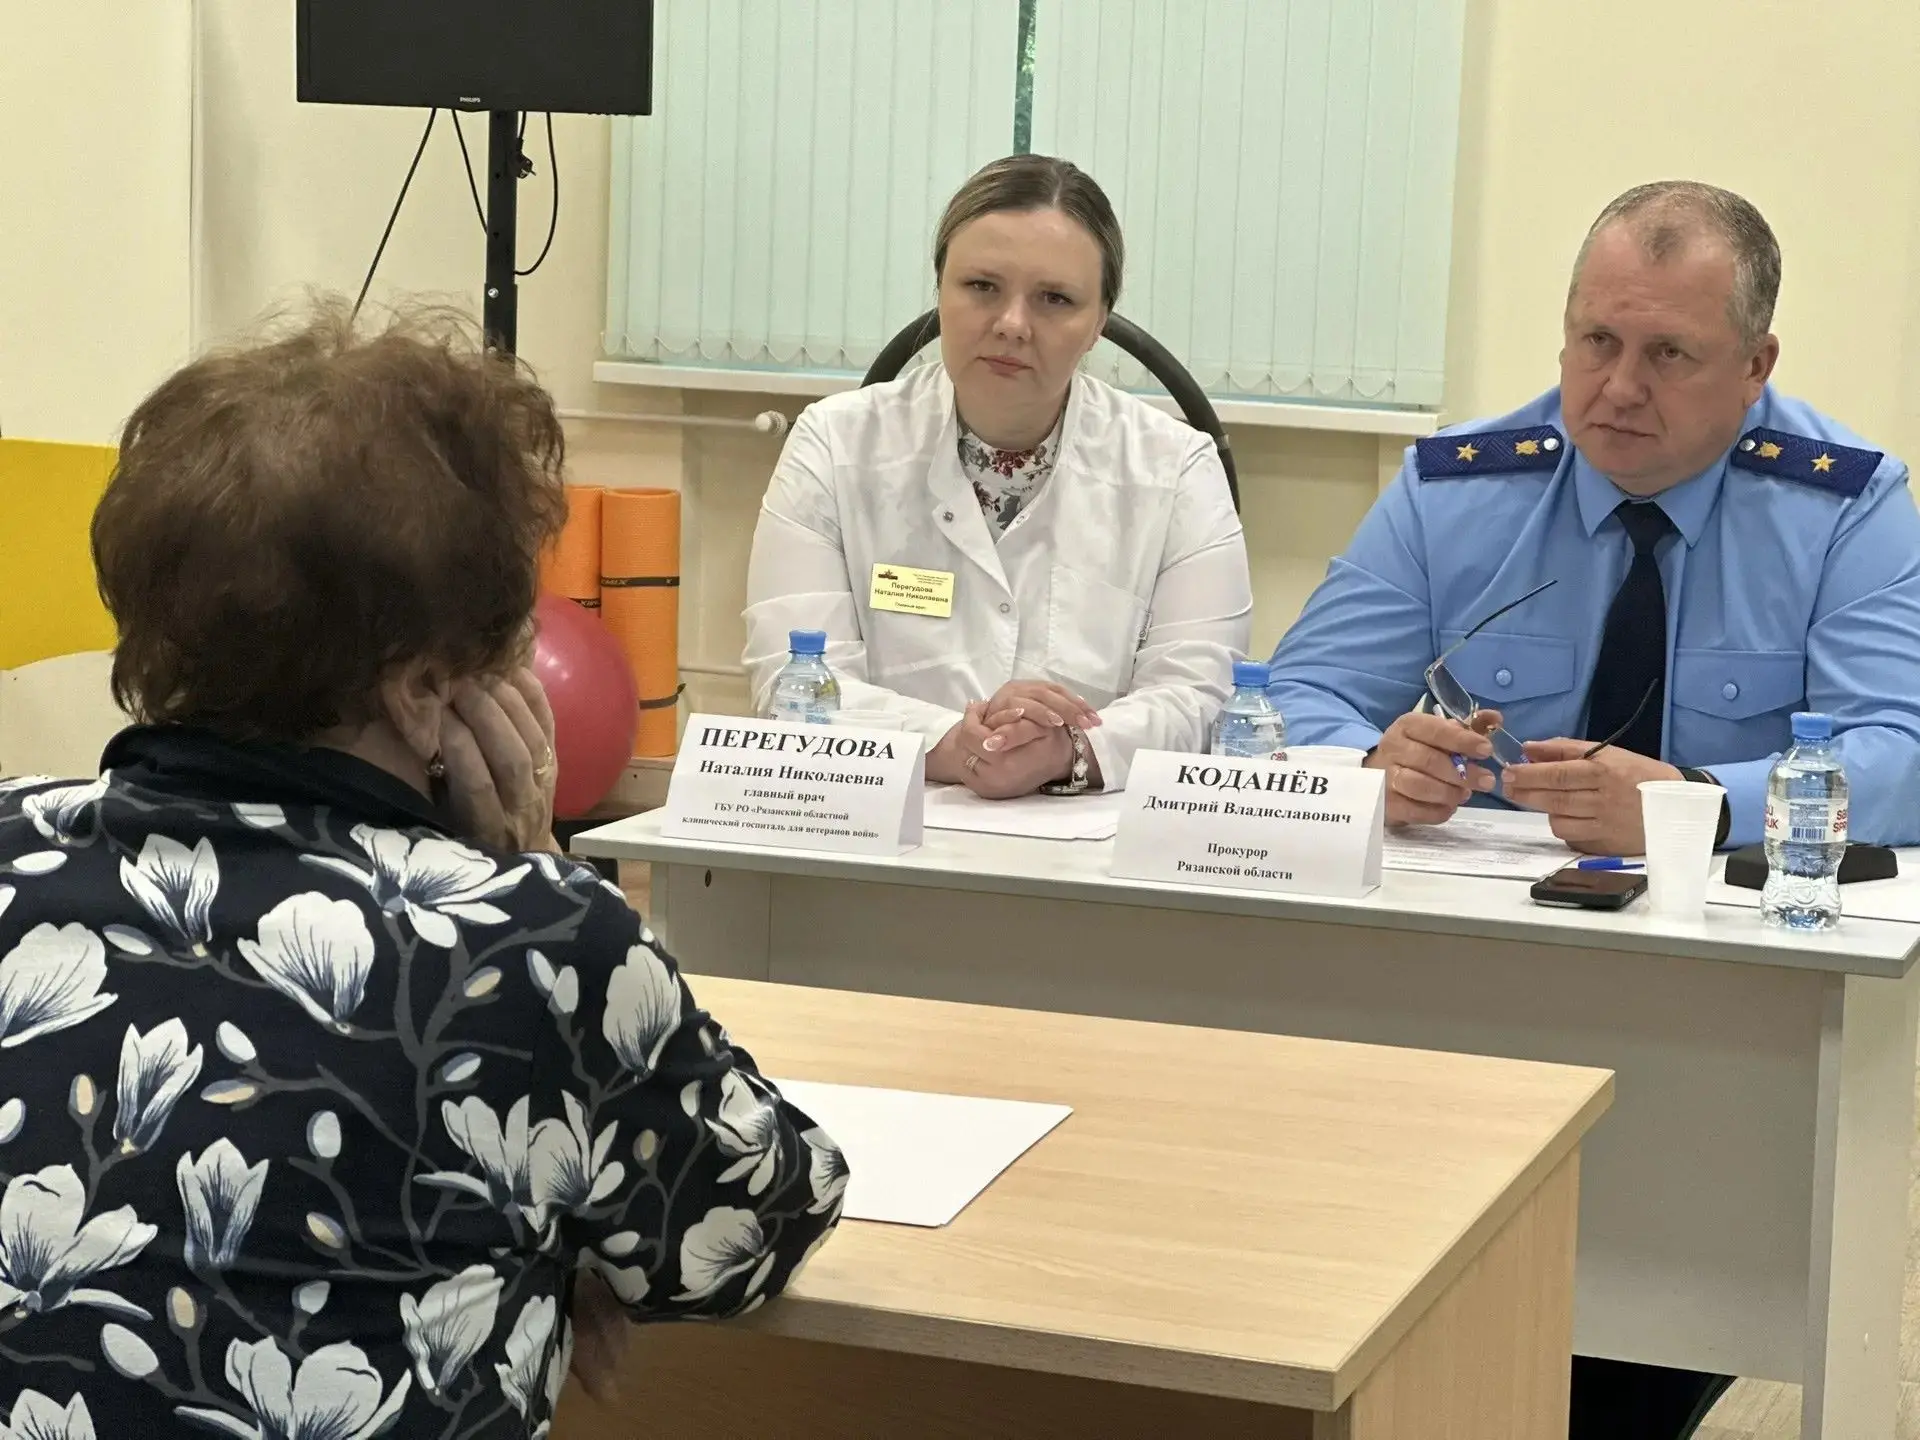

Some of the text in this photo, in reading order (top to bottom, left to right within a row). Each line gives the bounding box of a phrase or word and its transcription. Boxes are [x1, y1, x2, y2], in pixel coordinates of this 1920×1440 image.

[699, 727, 895, 760] ПЕРЕГУДОВА
[699, 759, 885, 787] Наталия Николаевна
[1176, 764, 1330, 795] КОДАНЁВ
[743, 788, 826, 803] главный врач
[714, 802, 850, 821] ГБУ РО «Рязанский областной
[1143, 795, 1352, 824] Дмитрий Владиславович
[681, 816, 880, 838] клинический госпиталь для ветеранов войн»
[1207, 843, 1268, 859] Прокурор
[1177, 860, 1293, 881] Рязанской области
